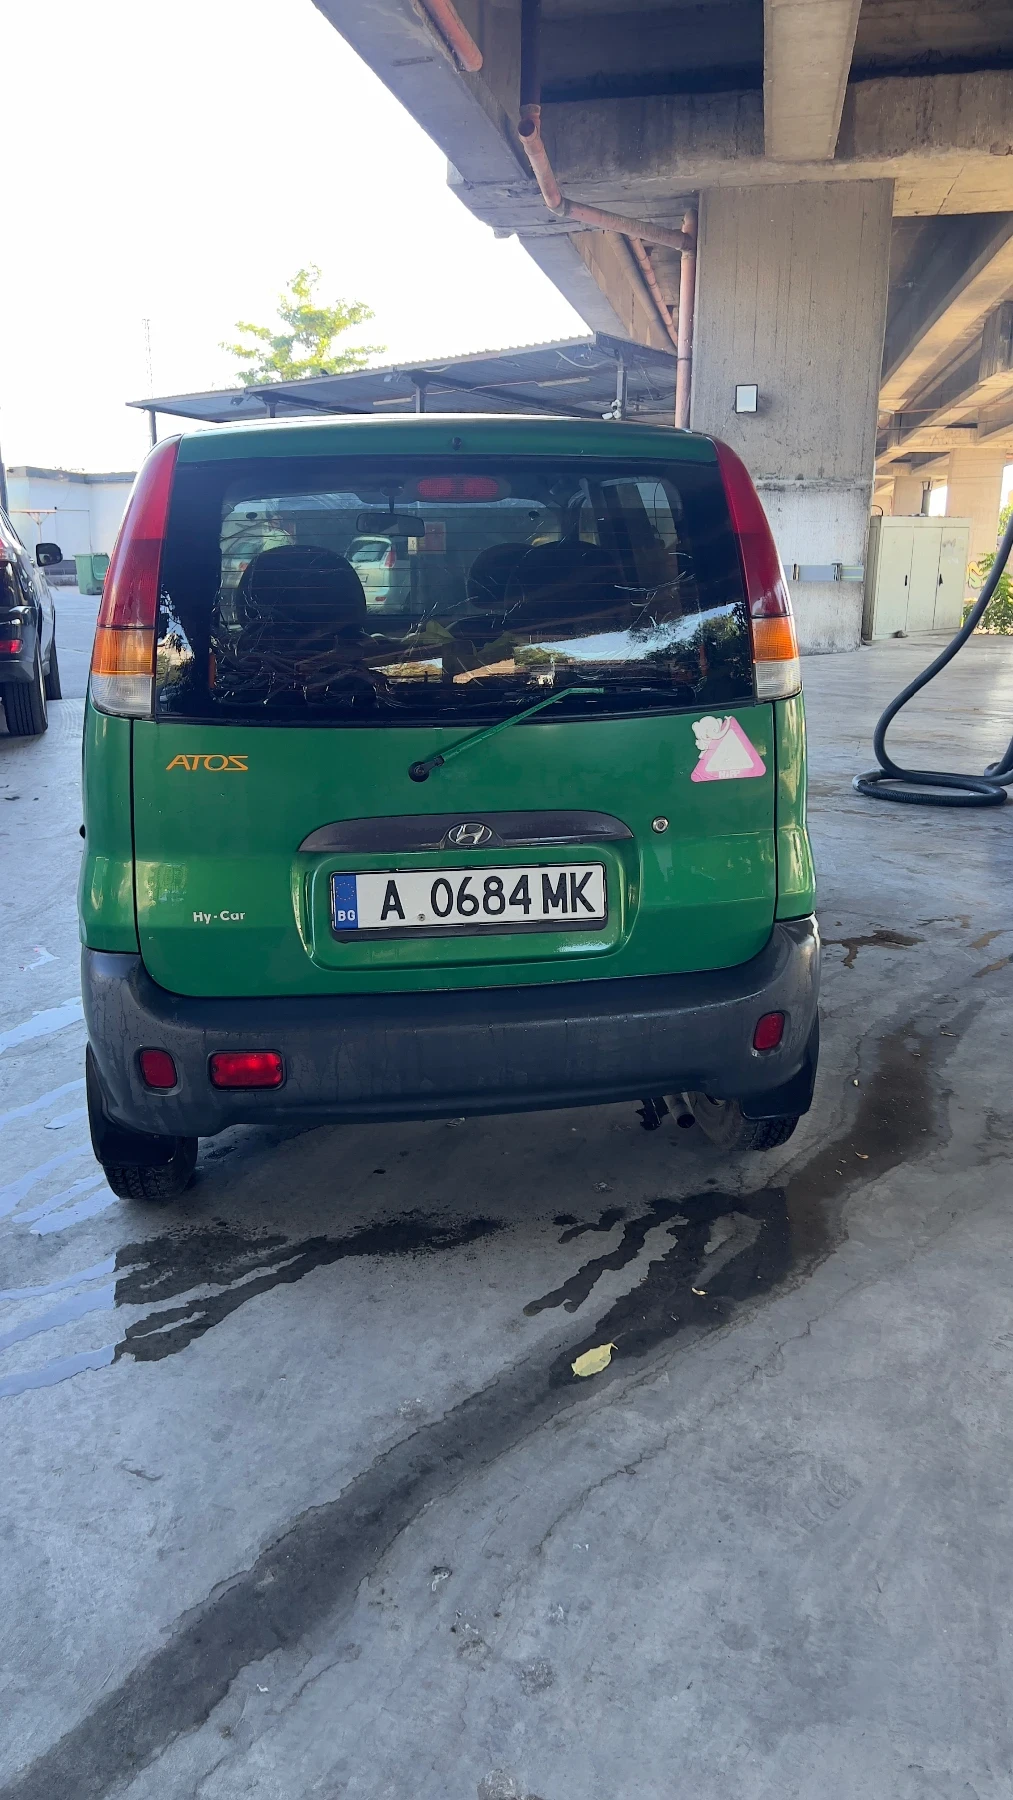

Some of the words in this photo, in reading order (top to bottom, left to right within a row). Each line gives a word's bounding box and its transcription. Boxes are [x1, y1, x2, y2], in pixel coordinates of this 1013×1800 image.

[165, 754, 249, 771] ATOS
[380, 879, 406, 921] A
[430, 874, 533, 918] 0684
[541, 871, 596, 915] MK
[192, 910, 246, 925] Hy-Car
[337, 909, 356, 922] BG
